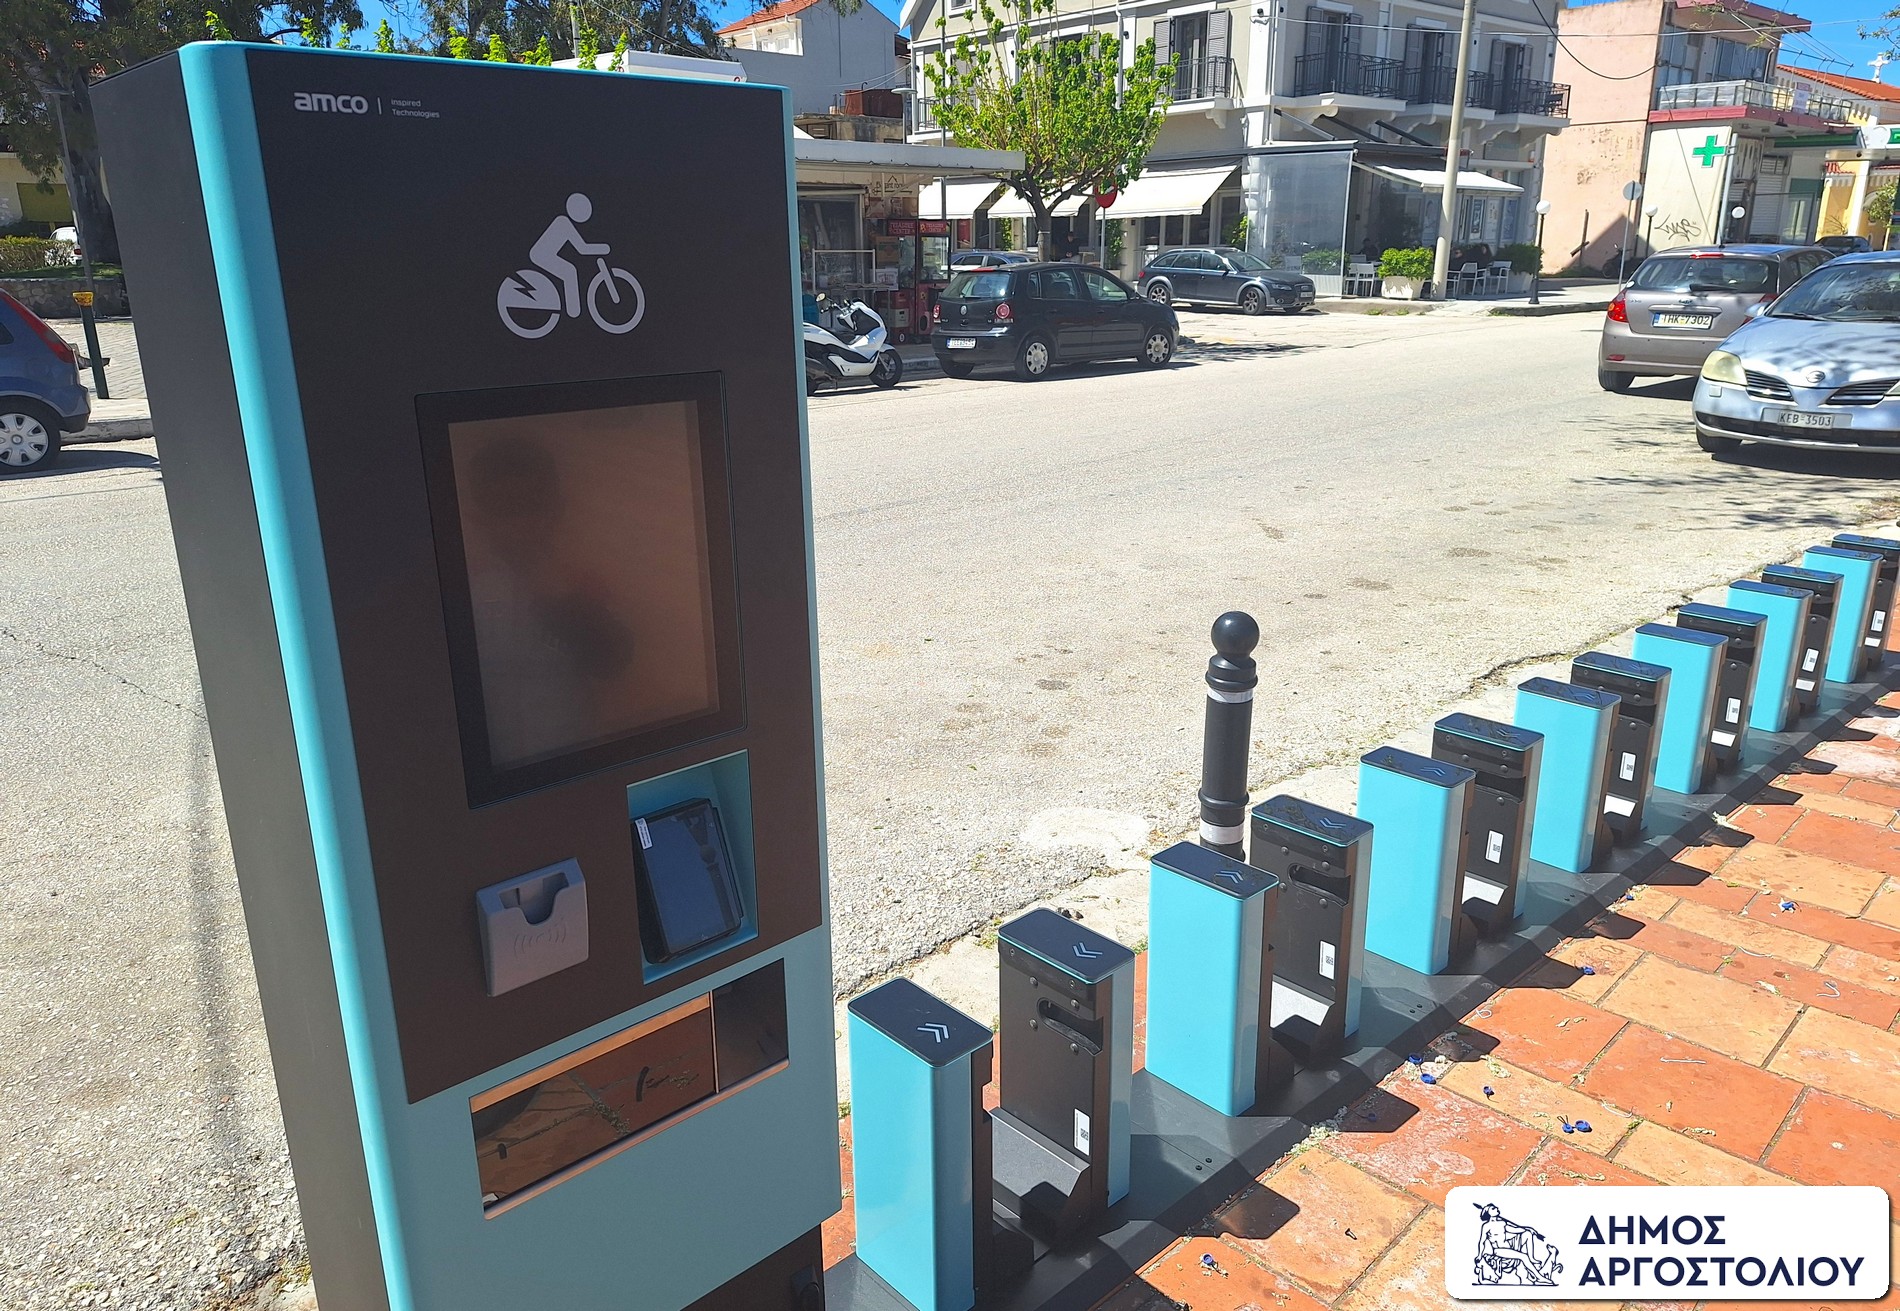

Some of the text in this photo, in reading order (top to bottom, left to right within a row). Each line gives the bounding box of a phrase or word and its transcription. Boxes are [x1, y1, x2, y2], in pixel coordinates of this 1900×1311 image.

[294, 92, 369, 114] amco
[392, 108, 440, 119] Technologies
[1780, 412, 1832, 427] KEB-3503
